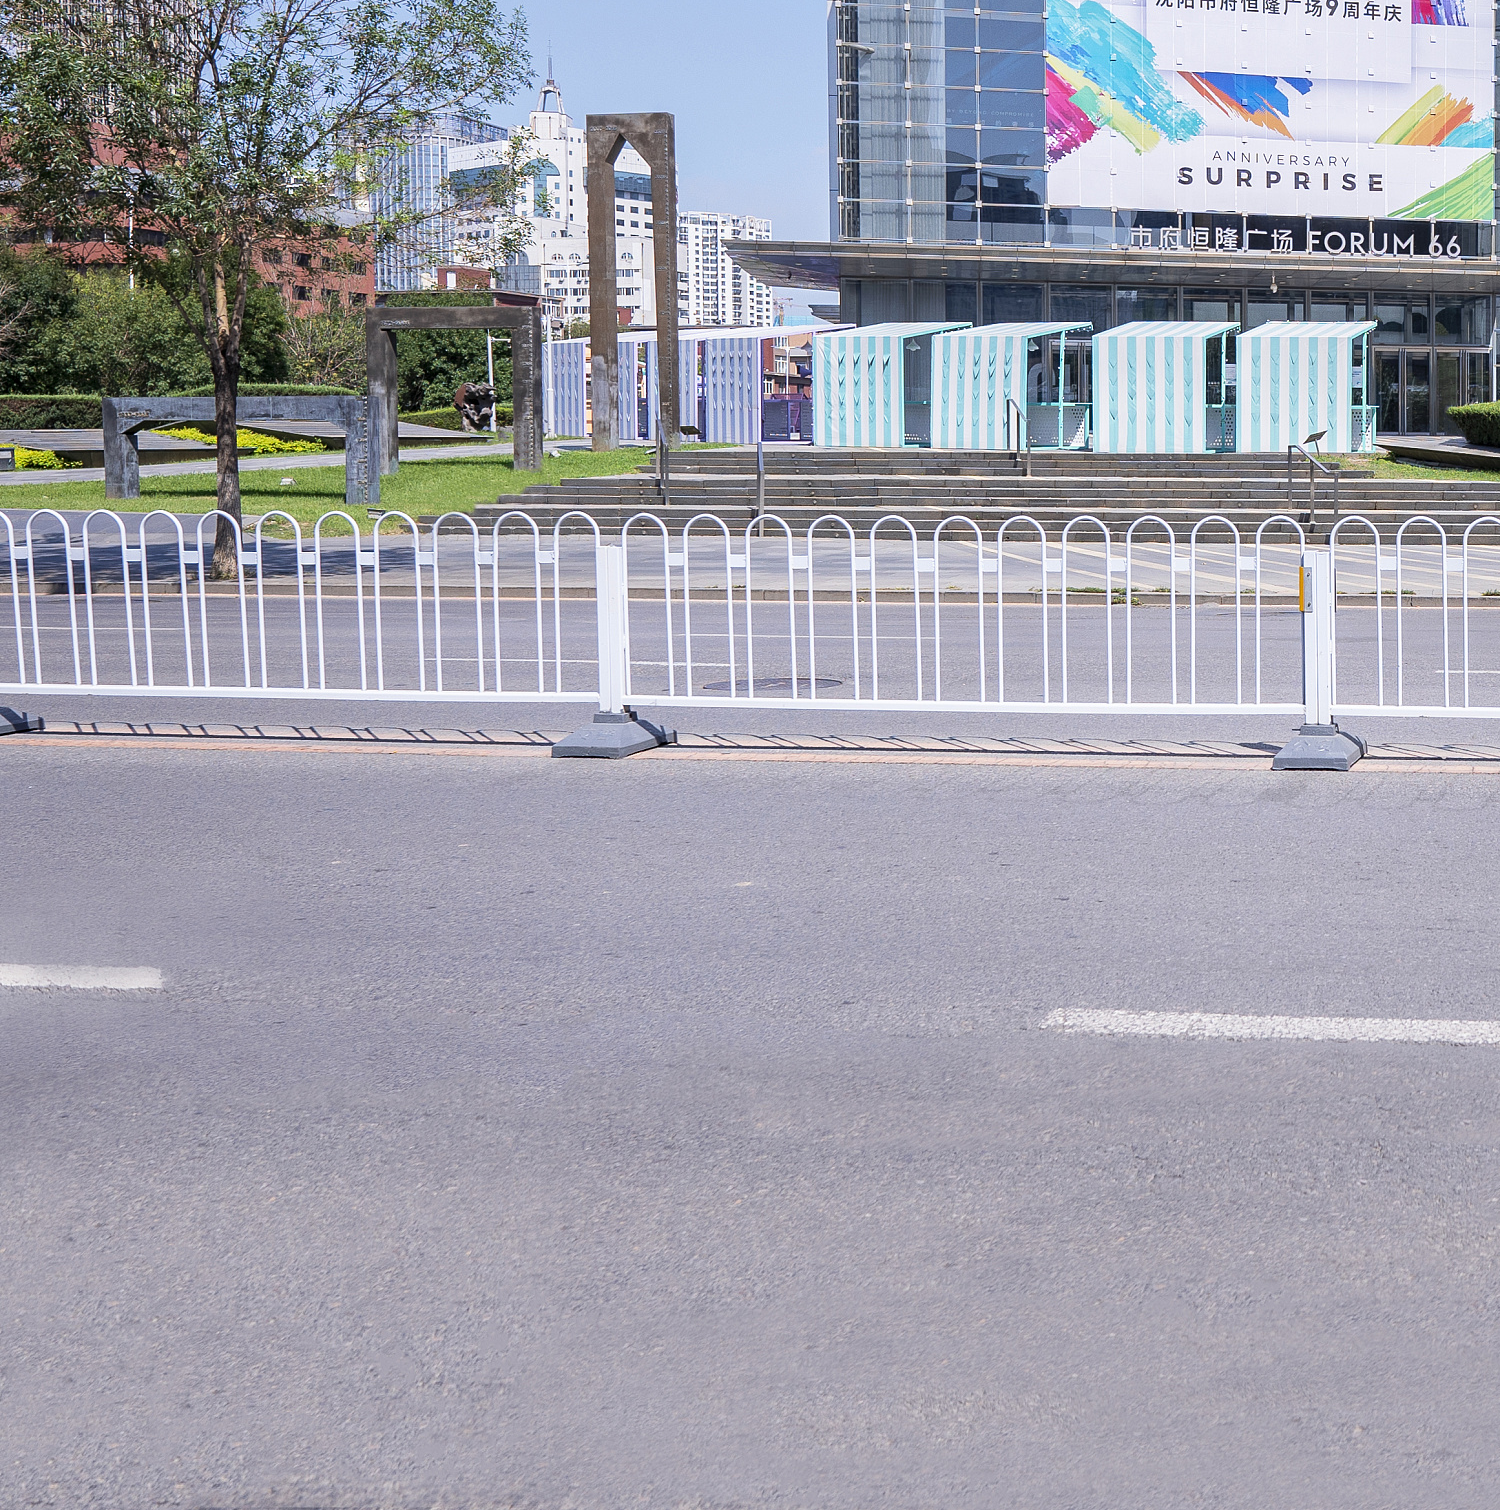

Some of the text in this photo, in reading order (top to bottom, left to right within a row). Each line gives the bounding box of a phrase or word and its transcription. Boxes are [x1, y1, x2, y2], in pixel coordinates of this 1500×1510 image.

[1212, 150, 1350, 168] ANNIVERSARY
[1177, 167, 1384, 193] SURPRISE
[1130, 225, 1462, 259] 市府恒隆广场 FORUM 66
